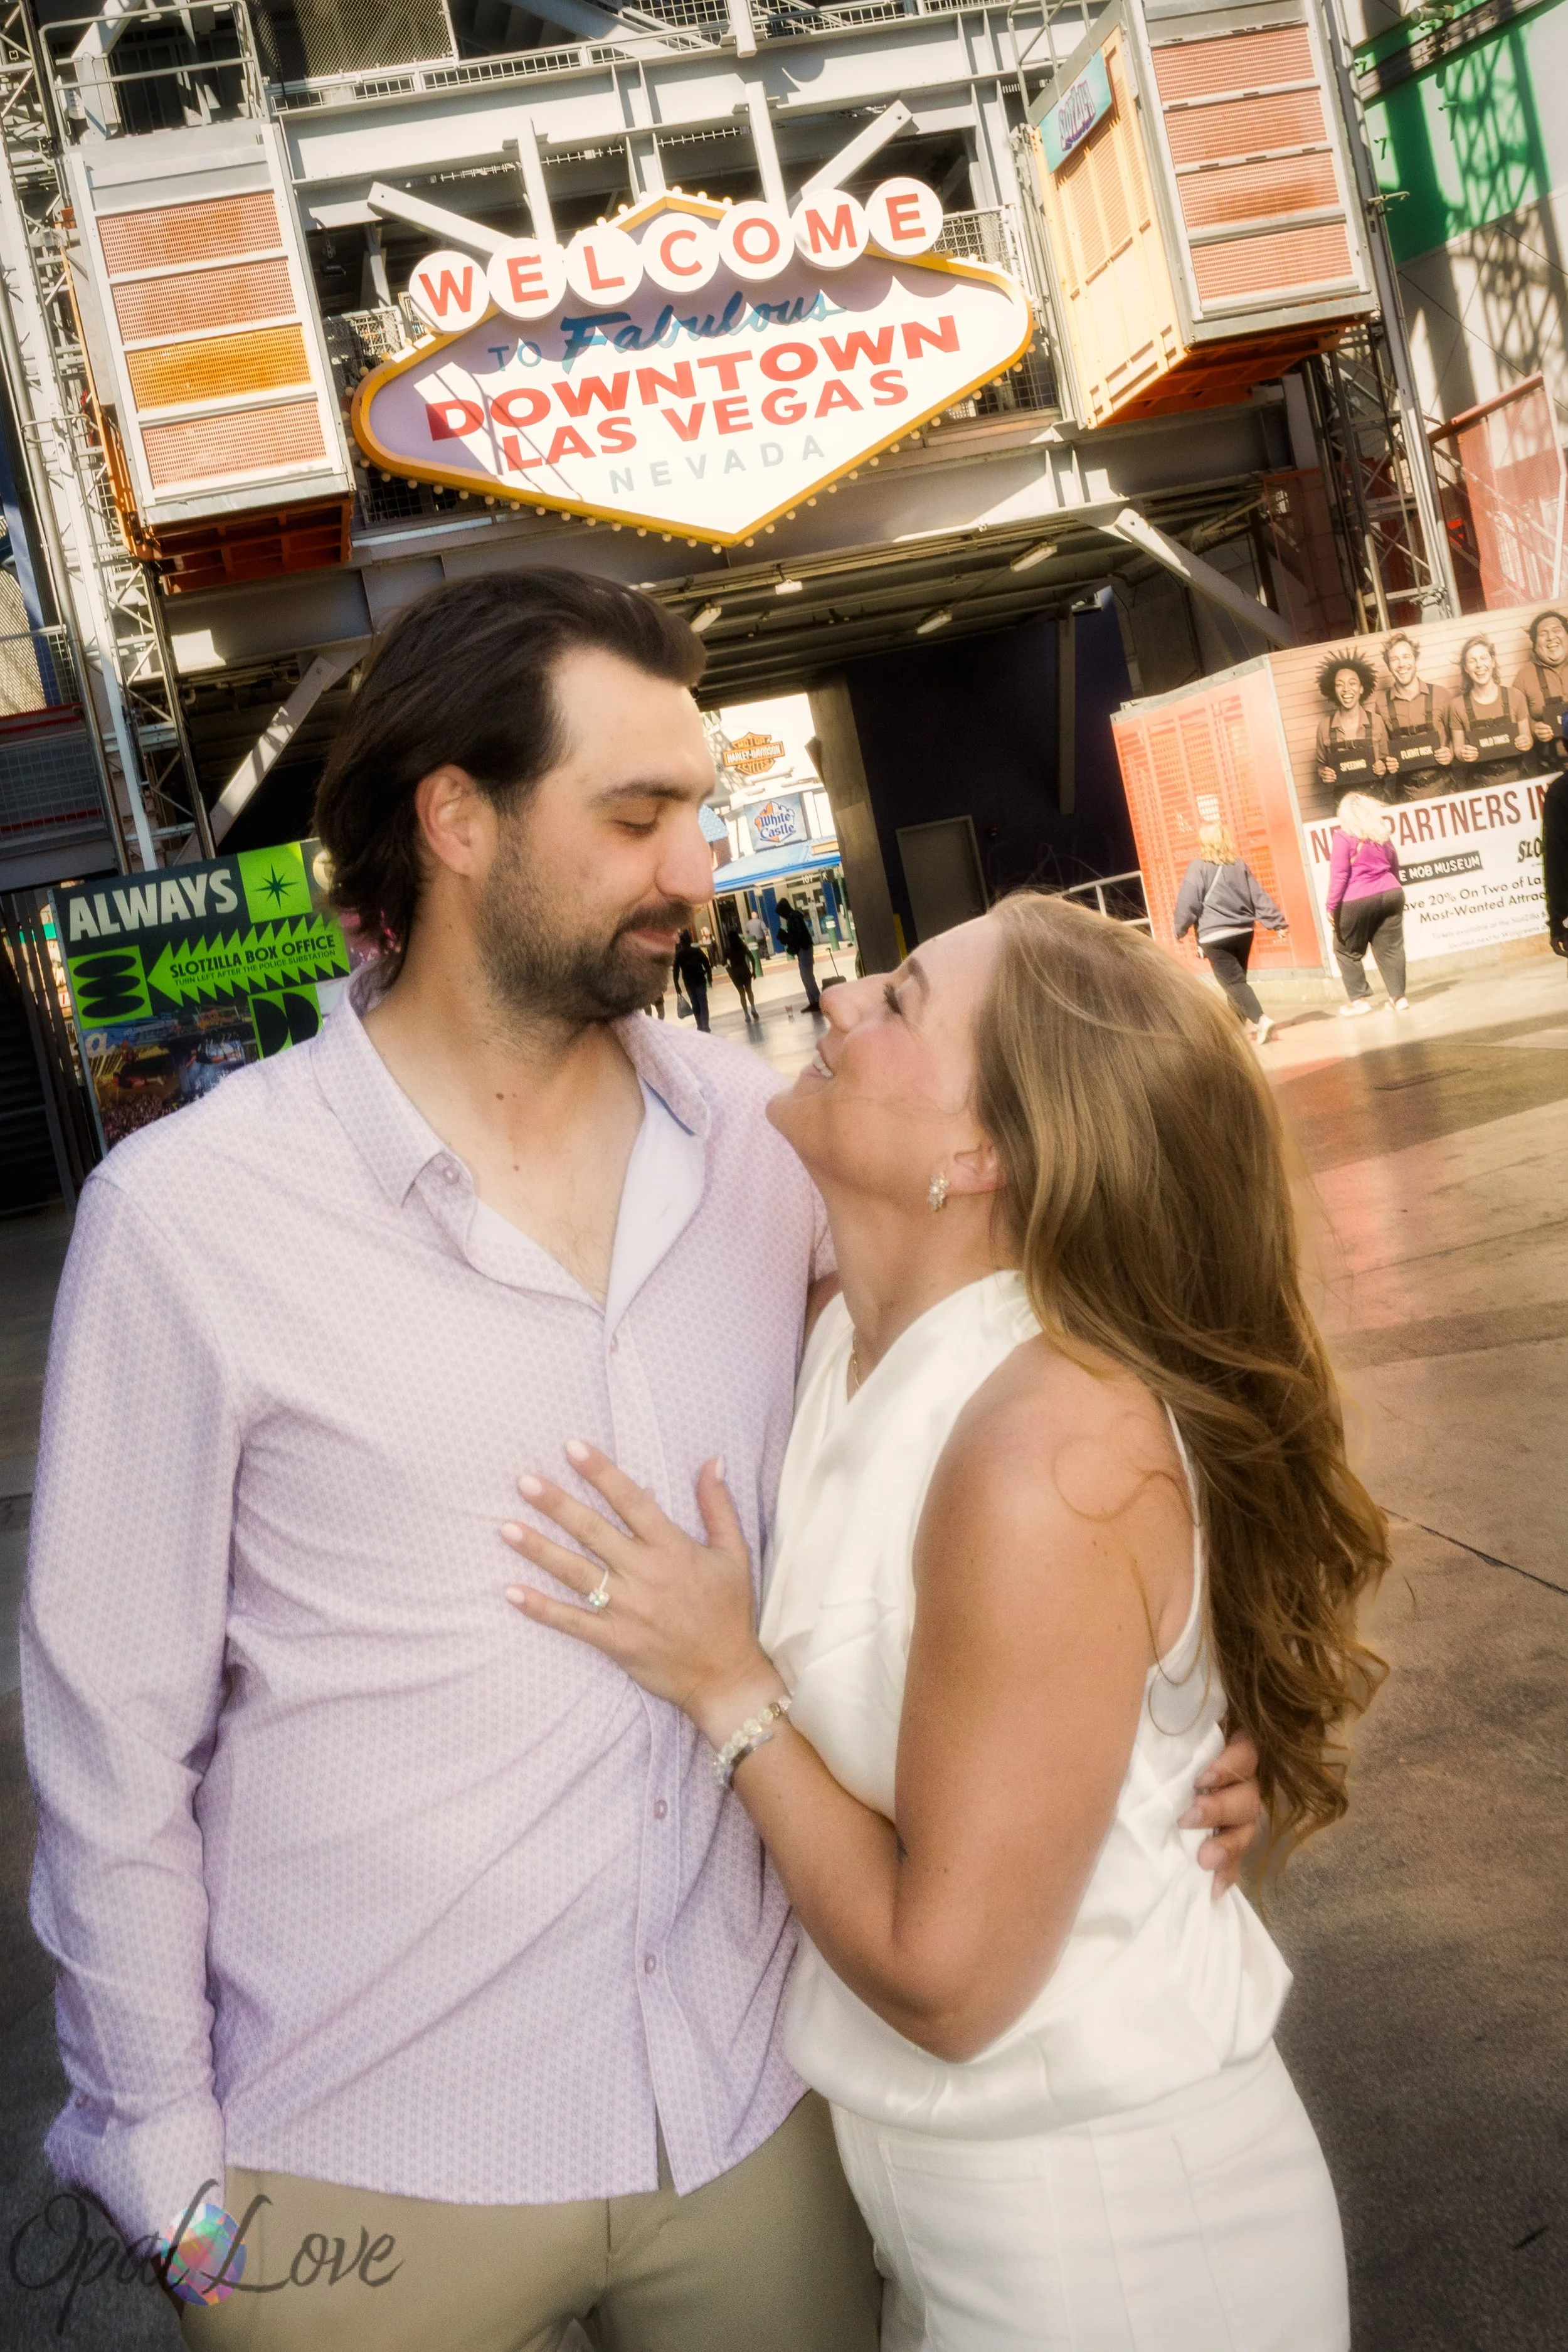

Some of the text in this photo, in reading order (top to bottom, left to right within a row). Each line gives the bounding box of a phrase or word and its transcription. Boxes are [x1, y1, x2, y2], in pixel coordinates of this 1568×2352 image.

[418, 193, 926, 317] WELCOME
[487, 291, 847, 374] TO Fabulous
[425, 315, 961, 441] DOWNTOWN
[501, 369, 909, 472] LAS VEGAS
[609, 433, 825, 495] NEVADA
[1479, 736, 1494, 748] WILD
[1340, 759, 1367, 772] SPEEDING
[760, 812, 790, 827] White
[760, 824, 795, 839] Castle
[1382, 790, 1521, 846] PARTNERS
[1409, 865, 1433, 879] MOB
[1434, 856, 1480, 874] MUSEUM
[70, 869, 238, 941] ALWAYS
[1403, 876, 1542, 911] ave 20% On Two of La
[1420, 897, 1504, 923] Most-Wanted
[170, 934, 336, 978] SLOTZILLA BOX OFFICE
[175, 950, 336, 986] TURN LEFT AFTER THE POLICE SUBSTATION
